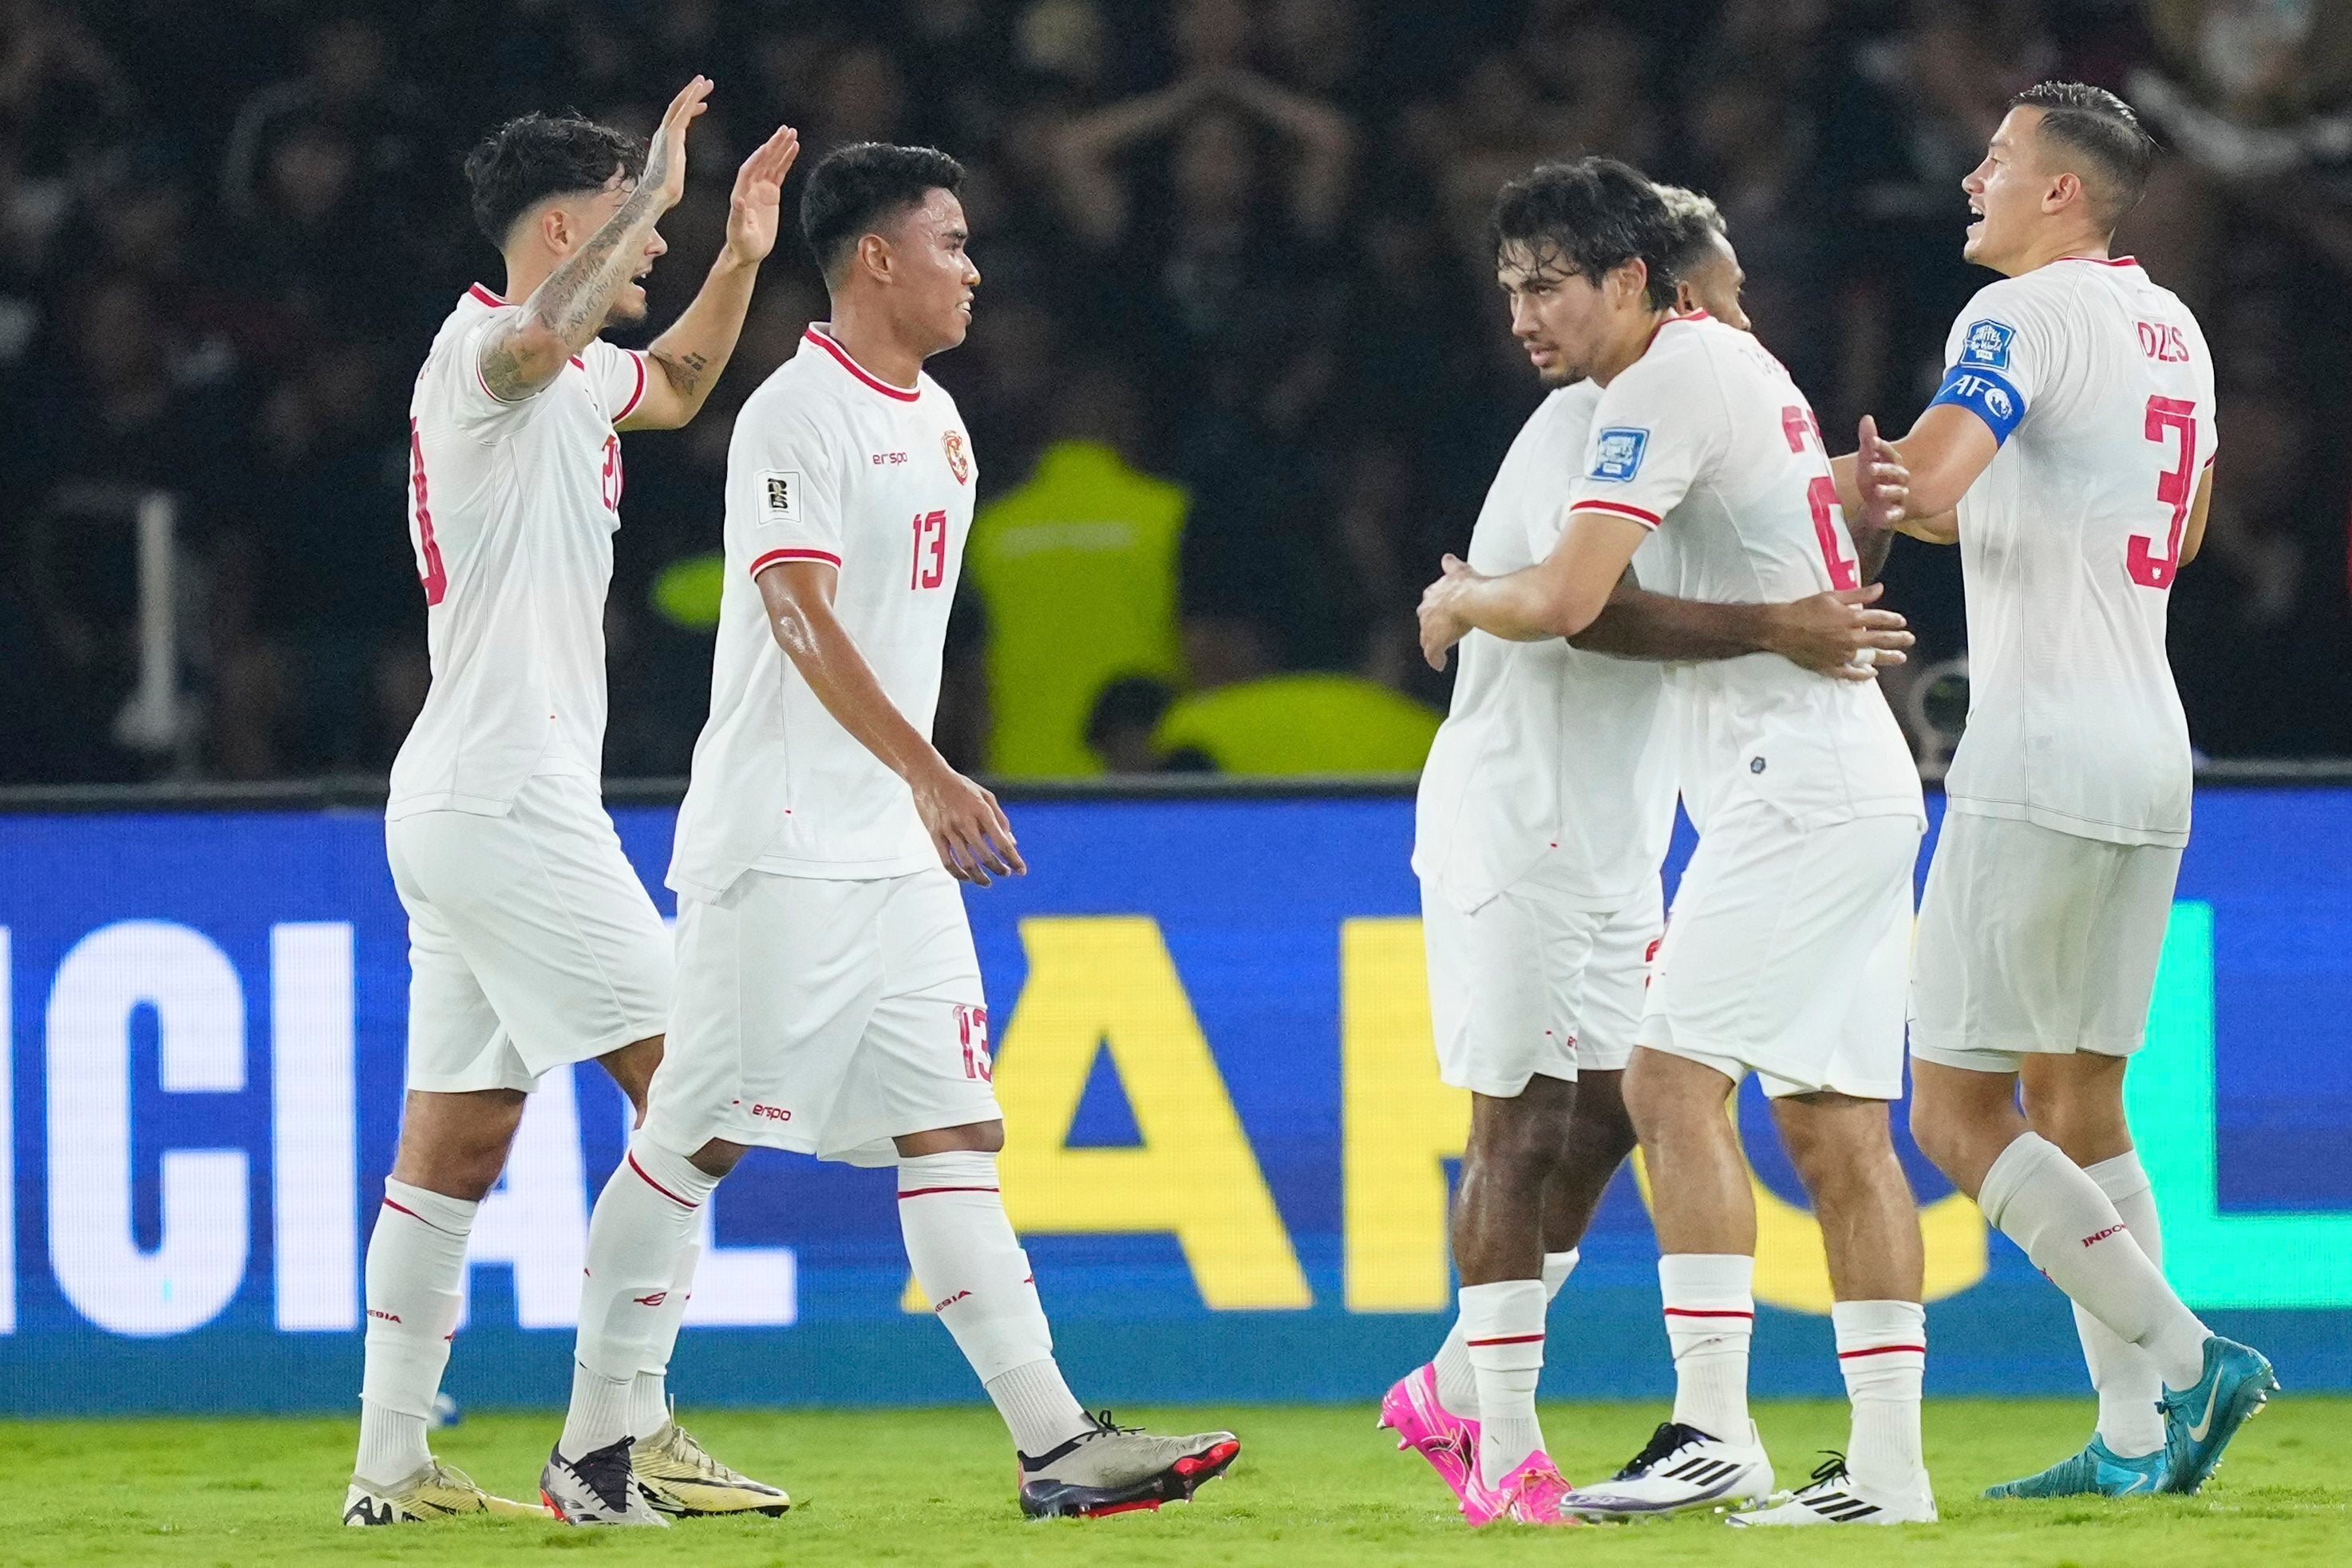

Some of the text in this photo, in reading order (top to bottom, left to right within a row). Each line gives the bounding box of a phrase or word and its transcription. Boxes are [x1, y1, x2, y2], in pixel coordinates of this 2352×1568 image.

[2132, 321, 2189, 362] DZS
[872, 452, 908, 466] erspo
[2126, 394, 2196, 590] 3
[911, 509, 947, 591] 13
[952, 1005, 992, 1083] 13
[0, 918, 797, 1337] CIAL
[752, 1104, 792, 1122] erspo
